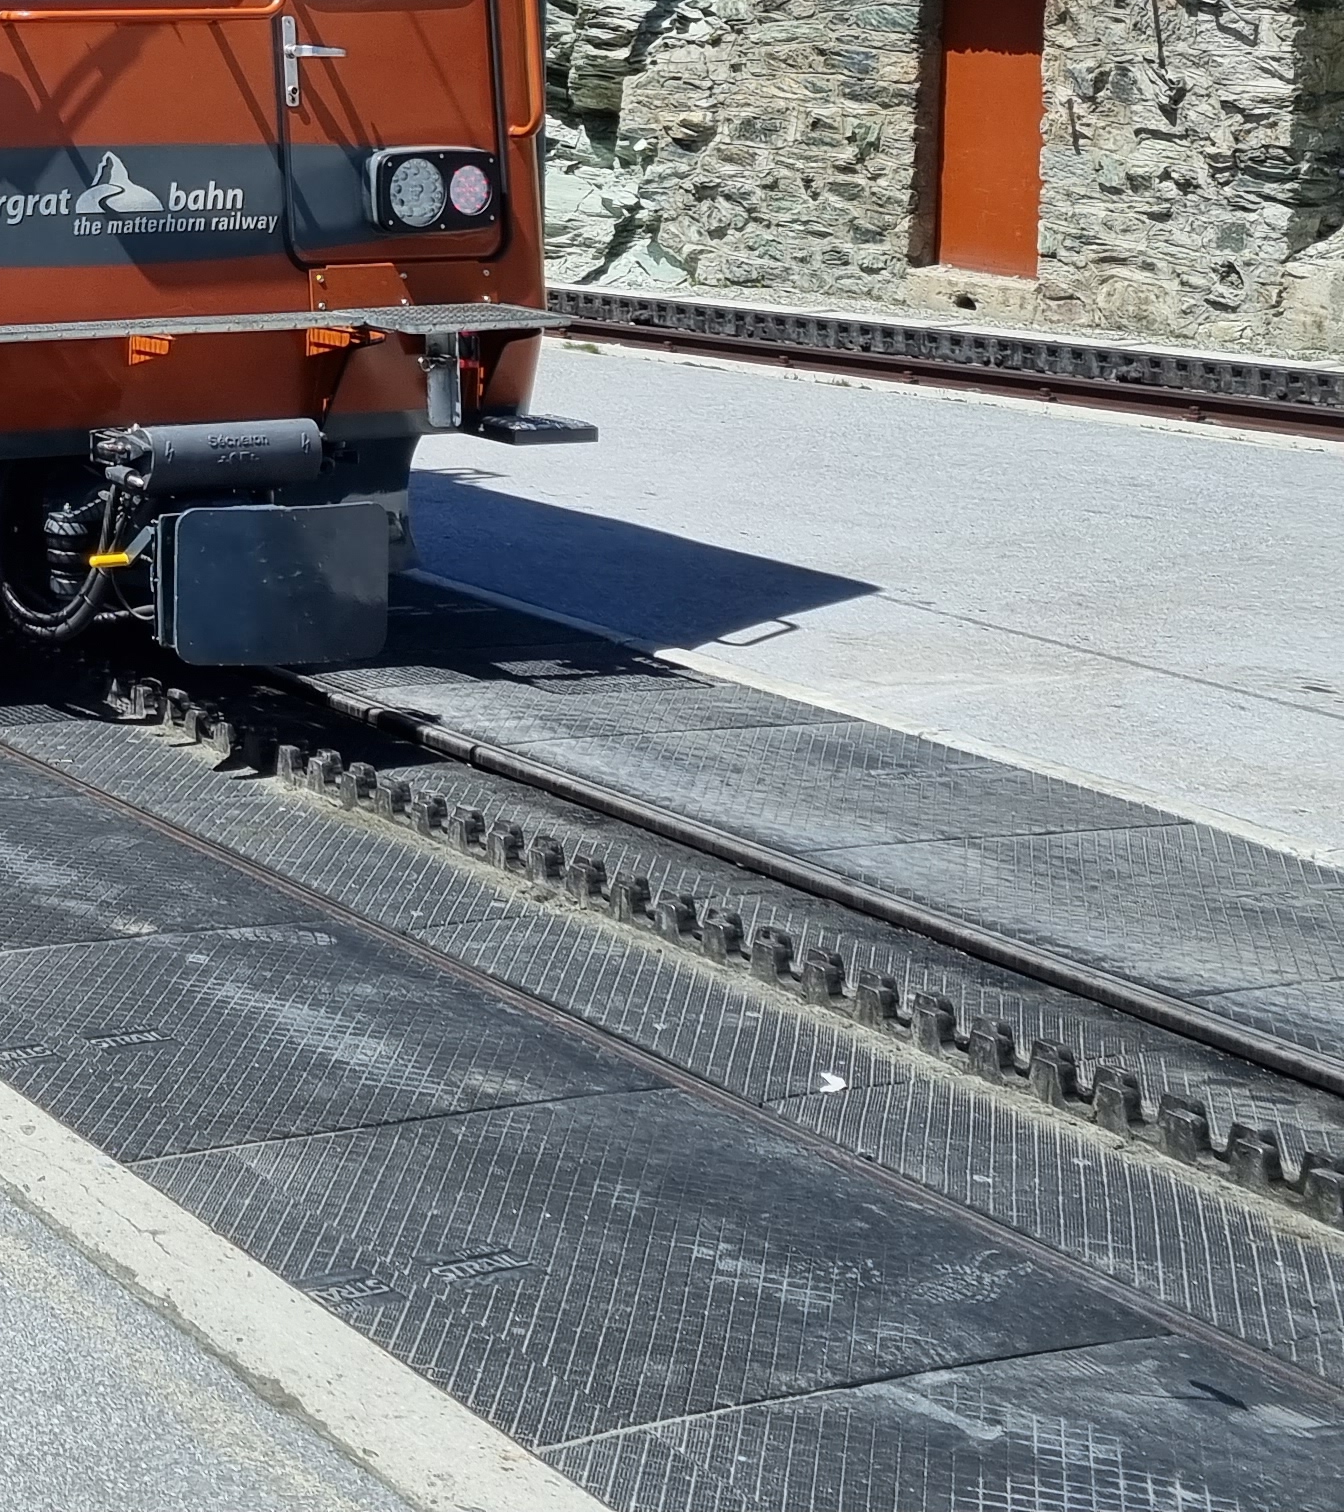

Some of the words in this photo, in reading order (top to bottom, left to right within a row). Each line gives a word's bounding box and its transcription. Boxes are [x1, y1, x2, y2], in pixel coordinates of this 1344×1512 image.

[169, 180, 245, 212] bahn
[73, 217, 102, 236] the
[107, 214, 206, 234] matterhorn
[211, 212, 279, 234] railway
[431, 1253, 532, 1283] STRAIL
